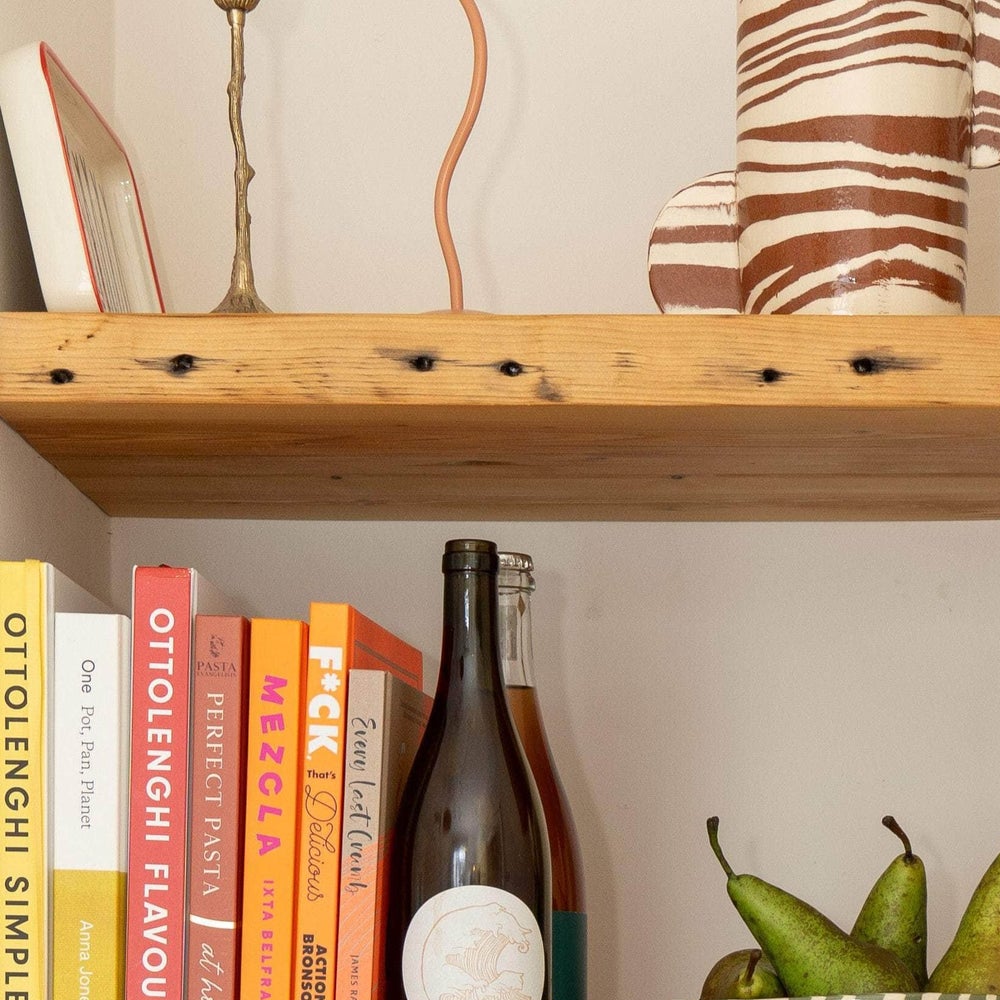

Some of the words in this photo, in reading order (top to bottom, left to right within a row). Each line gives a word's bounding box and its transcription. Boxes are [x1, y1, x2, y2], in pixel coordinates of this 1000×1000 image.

[81, 659, 96, 694] One
[197, 661, 237, 672] PASTA
[4, 612, 30, 853] OTTOLENGHI
[79, 706, 95, 736] Pot,
[145, 607, 175, 842] OTTOLENGHI
[79, 741, 95, 776] Pan,
[204, 693, 225, 808] PERFECT
[256, 675, 288, 856] MEZCLA
[351, 716, 377, 773] Every
[306, 769, 337, 780] That's
[79, 782, 95, 830] Planet
[202, 817, 222, 896] PASTA
[305, 784, 338, 902] Delicious
[345, 830, 373, 896] Crumb
[262, 879, 274, 922] IXTA
[79, 920, 94, 962] Anna
[201, 942, 224, 976] at
[349, 953, 359, 986] JAMES
